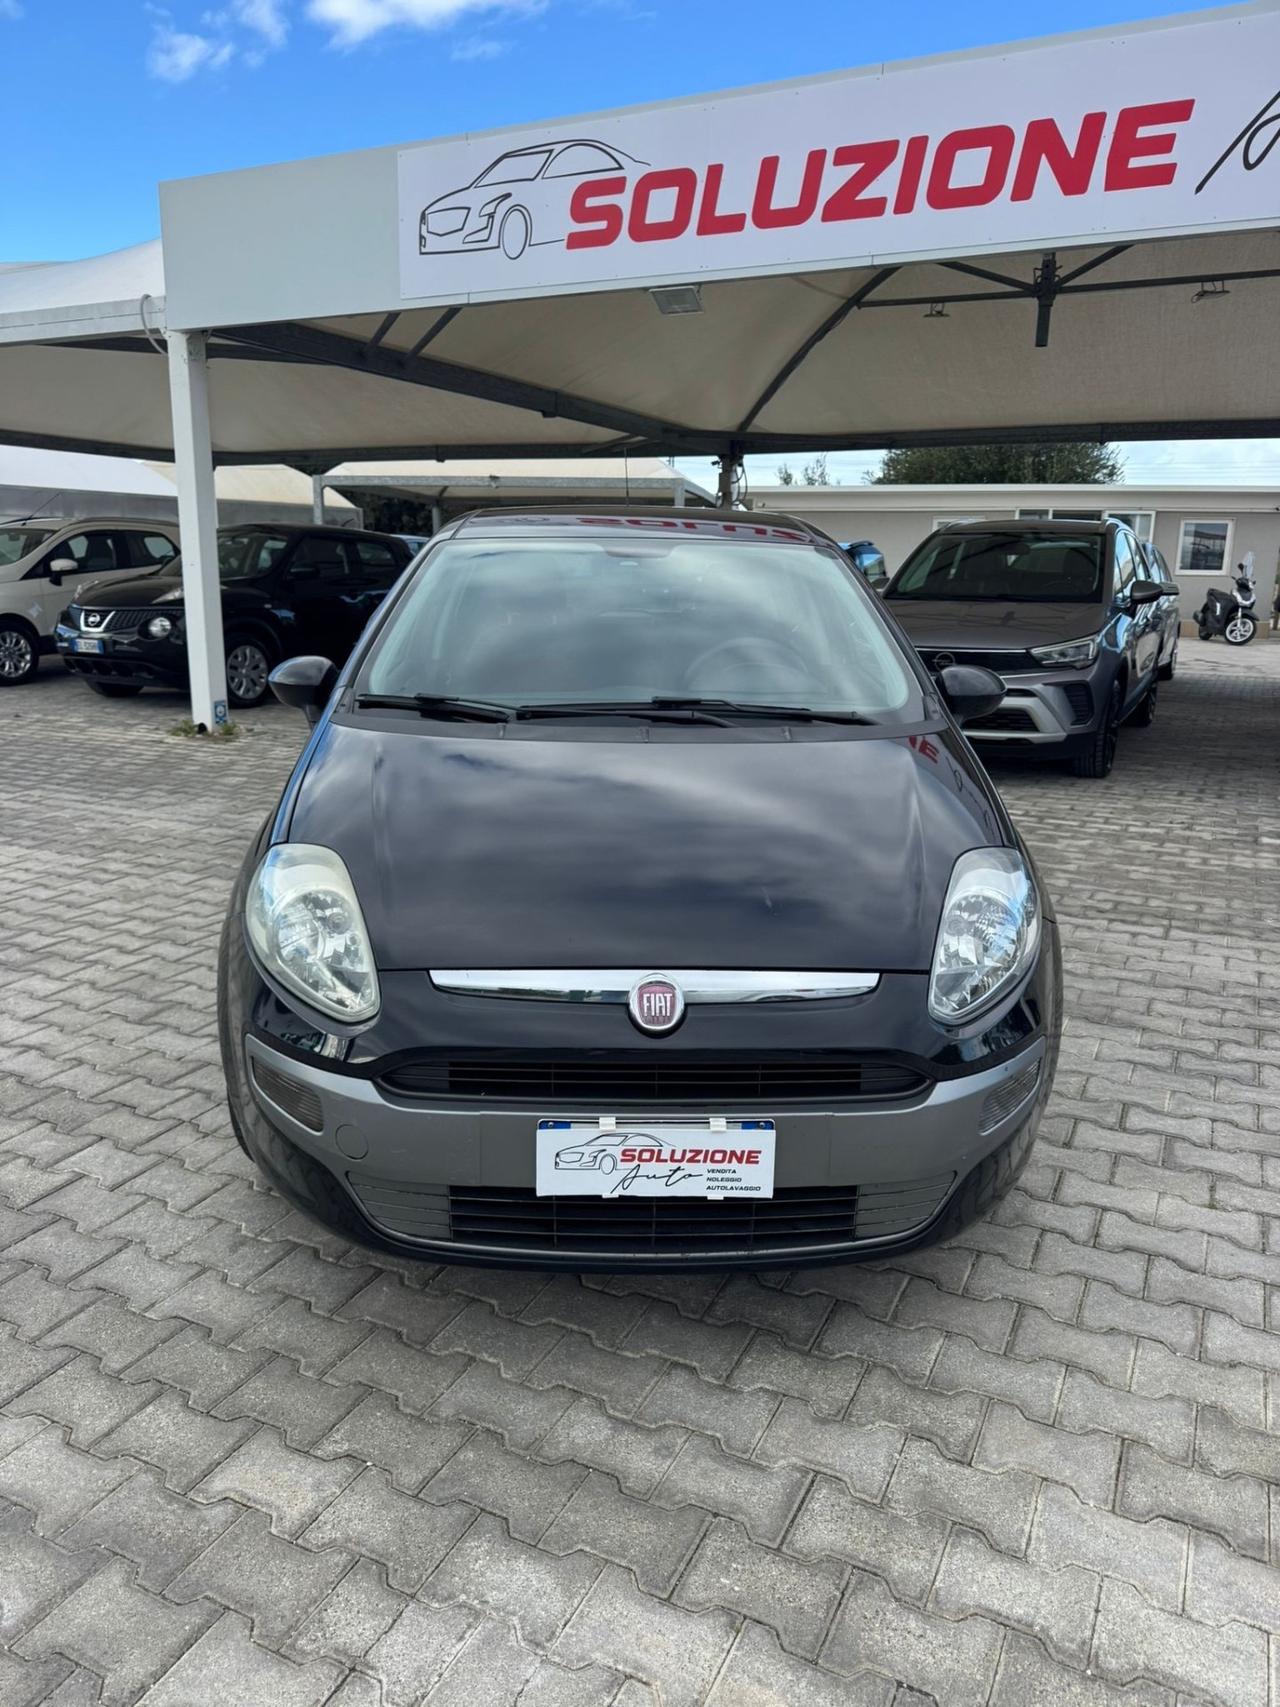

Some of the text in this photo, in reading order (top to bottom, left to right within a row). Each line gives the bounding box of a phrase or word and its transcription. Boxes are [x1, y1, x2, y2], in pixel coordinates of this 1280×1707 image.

[567, 98, 1195, 251] SOLUZIONE
[643, 993, 673, 1017] FIAT
[620, 1148, 762, 1165] SOLUZIONE
[611, 1164, 704, 1194] Auto
